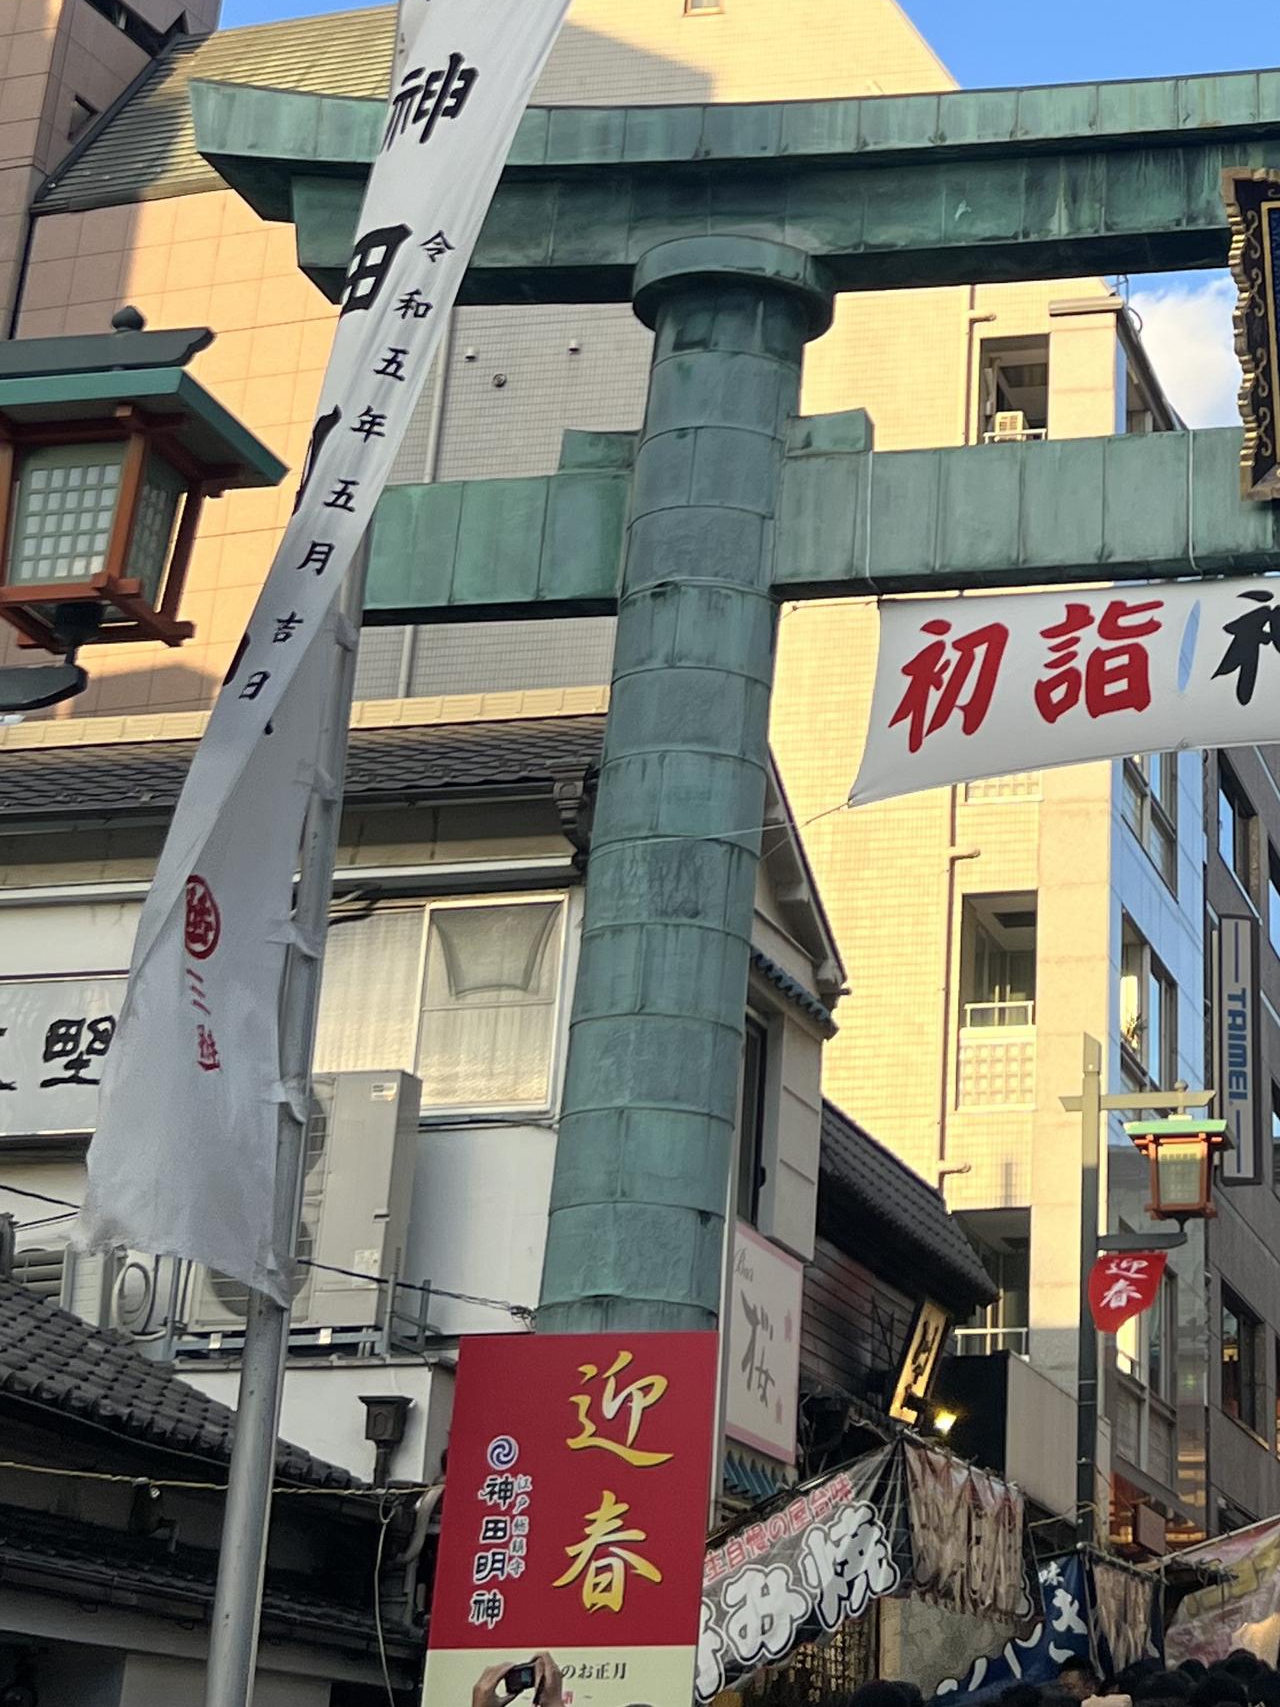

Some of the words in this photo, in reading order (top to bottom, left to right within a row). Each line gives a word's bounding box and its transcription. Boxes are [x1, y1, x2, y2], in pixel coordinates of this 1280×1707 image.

[888, 600, 1164, 754] 初詣
[1227, 988, 1248, 1100] TAIMEI
[469, 1474, 516, 1630] 神田明神
[551, 1350, 675, 1614] 迎春
